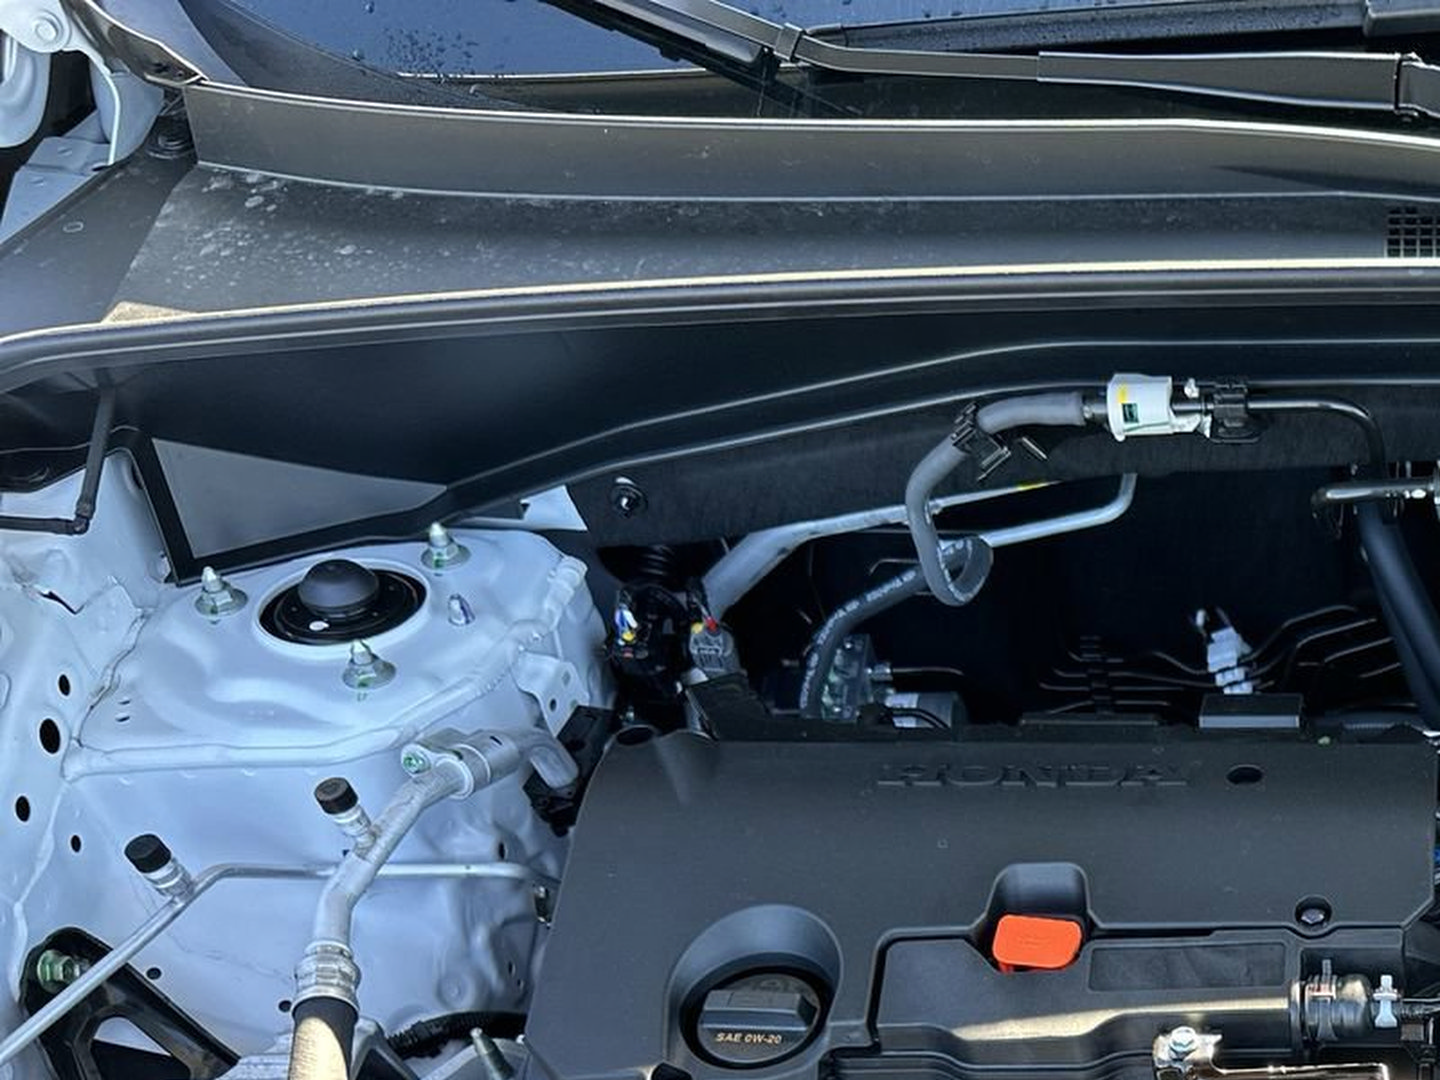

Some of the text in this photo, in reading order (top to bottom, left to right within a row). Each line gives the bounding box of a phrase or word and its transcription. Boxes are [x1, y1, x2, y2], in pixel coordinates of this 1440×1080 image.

[877, 763, 1188, 788] HONDA
[716, 1031, 783, 1045] SAE 0W-20
